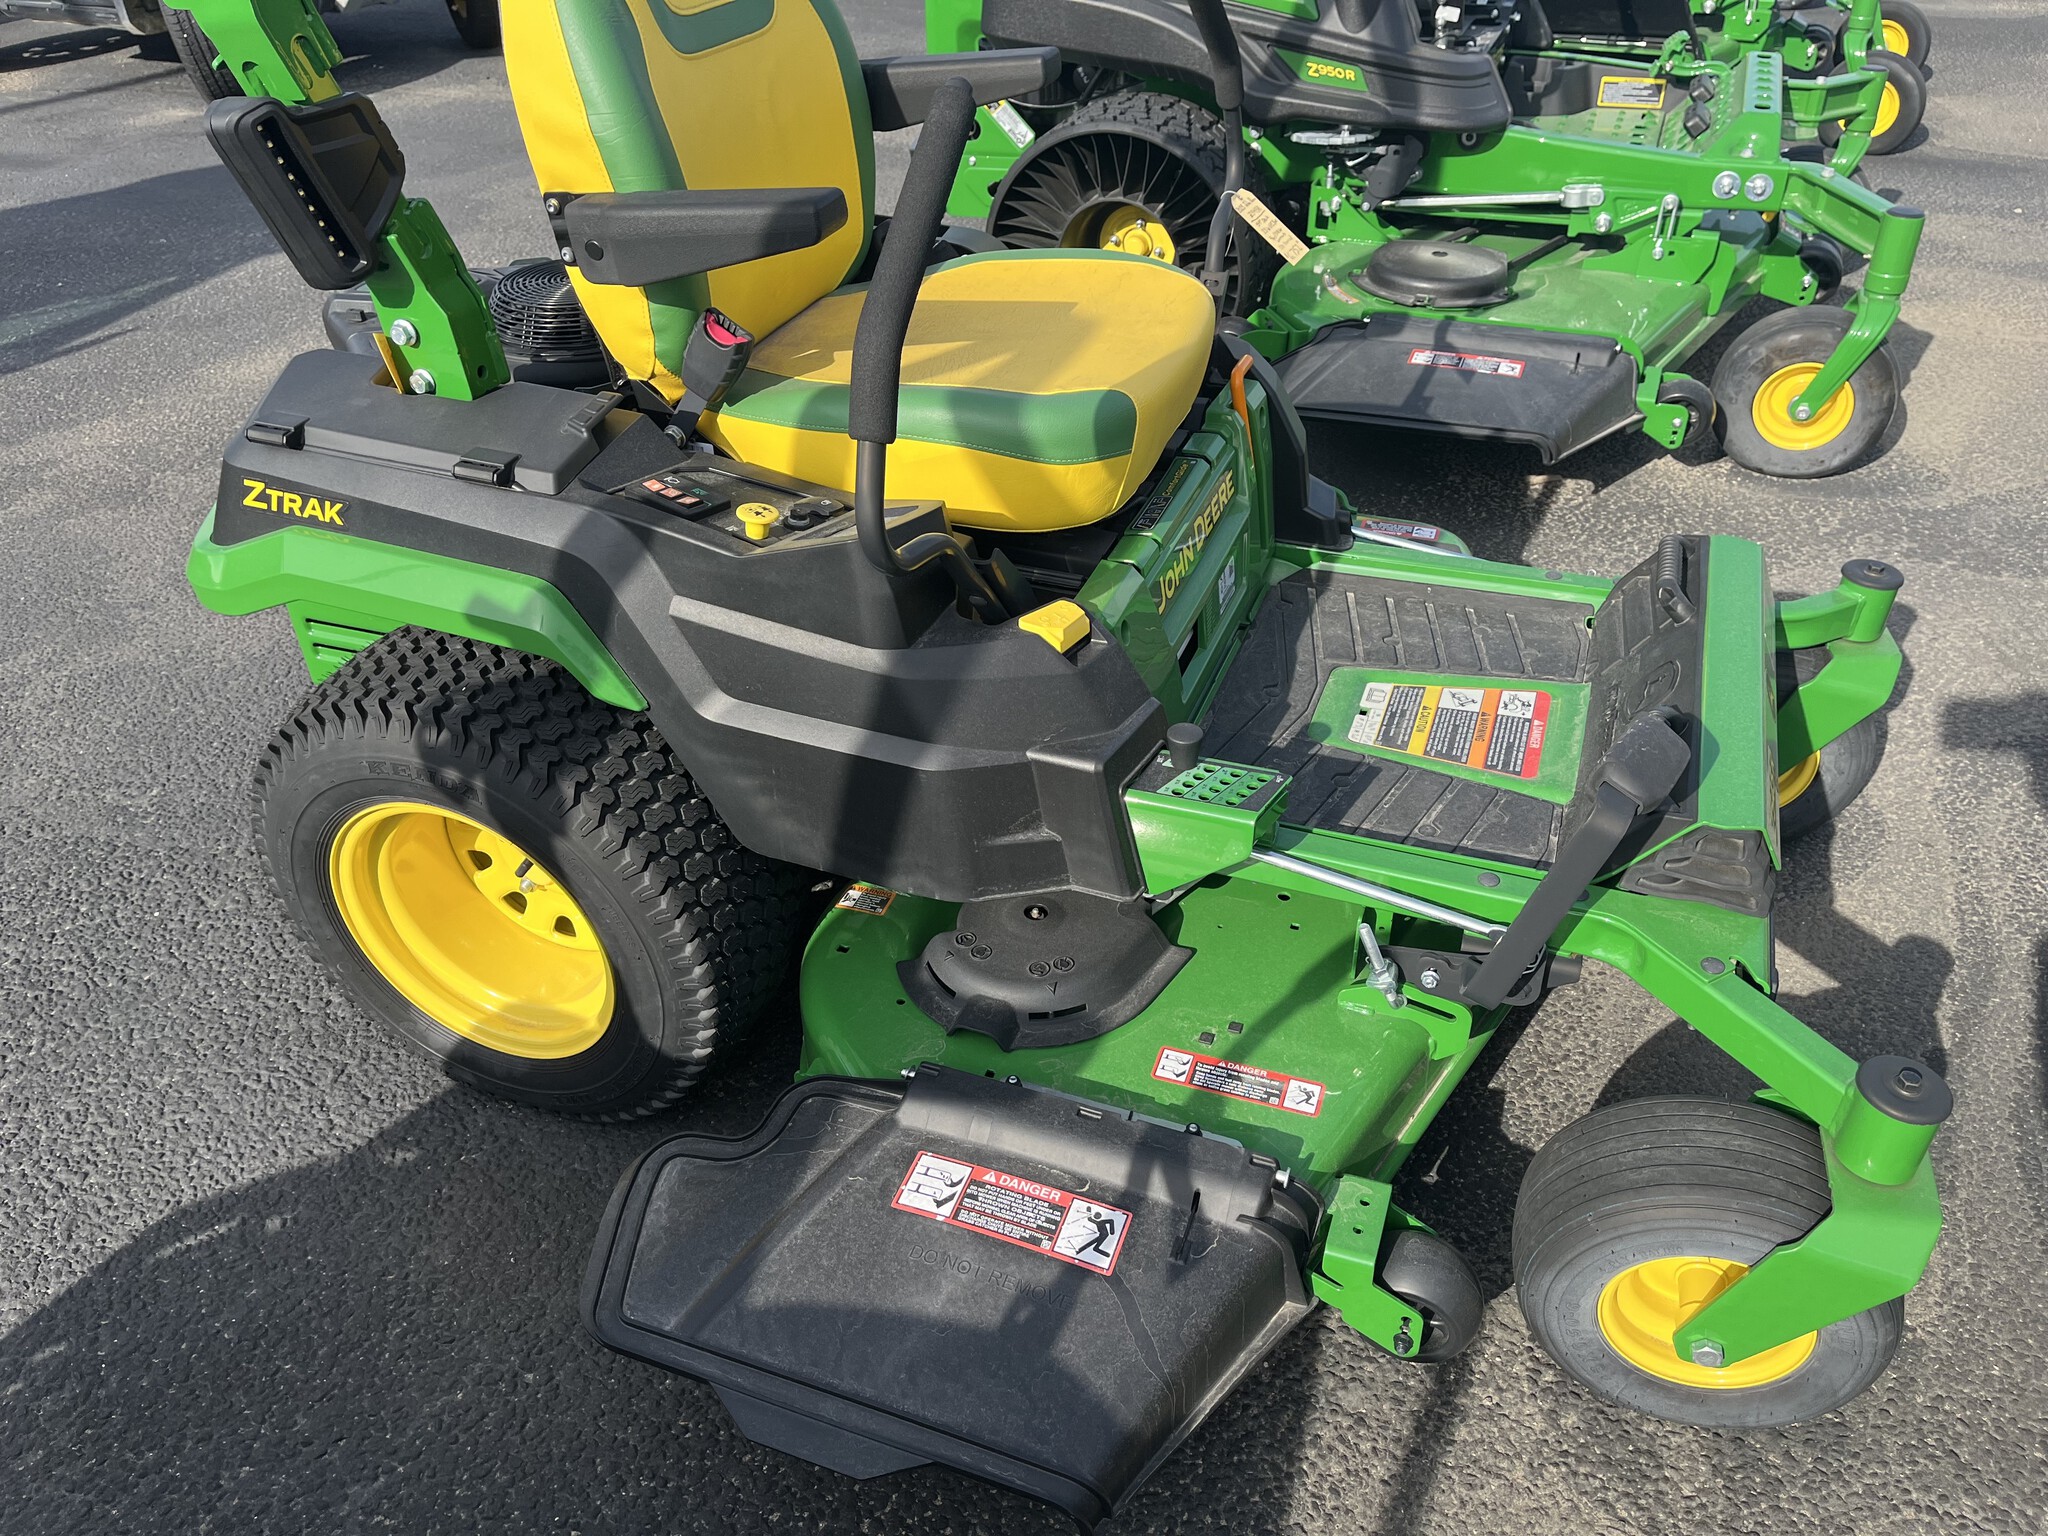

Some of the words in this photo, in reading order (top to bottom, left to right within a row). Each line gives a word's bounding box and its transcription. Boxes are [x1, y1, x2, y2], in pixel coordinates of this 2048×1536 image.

[1306, 62, 1355, 81] Z950R
[243, 479, 344, 526] ZTRAK
[1158, 536, 1194, 615] JOHN
[1193, 469, 1235, 552] DEERE
[1415, 707, 1431, 733] CAUTION
[1474, 717, 1488, 742] WARNING
[1529, 724, 1545, 749] DANGER
[360, 760, 482, 805] KENDA
[858, 886, 893, 897] WARNING
[1227, 1062, 1267, 1076] DANGER
[984, 1184, 1023, 1199] ROTATING
[1023, 1196, 1049, 1207] BLADE
[998, 1174, 1061, 1201] DANGER
[976, 1196, 1010, 1210] THROWN
[1010, 1207, 1046, 1221] OBJECTS
[909, 1244, 938, 1264] DO
[943, 1254, 985, 1279] NOT
[987, 1269, 1073, 1310] REMOVE
